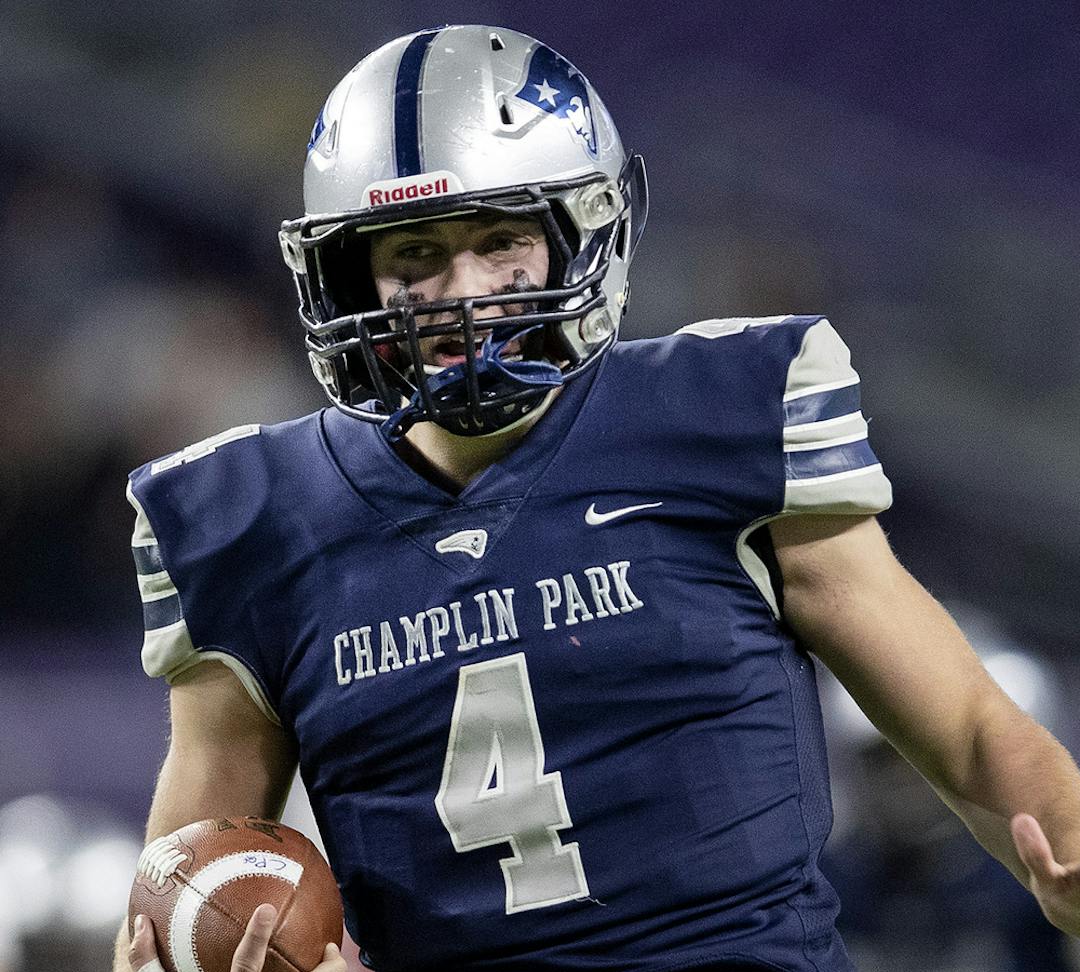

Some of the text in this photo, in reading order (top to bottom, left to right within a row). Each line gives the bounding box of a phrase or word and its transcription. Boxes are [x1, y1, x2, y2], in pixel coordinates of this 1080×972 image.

[369, 178, 448, 206] Riddell
[334, 560, 645, 686] CHAMPLIN PARK
[435, 652, 590, 914] 4
